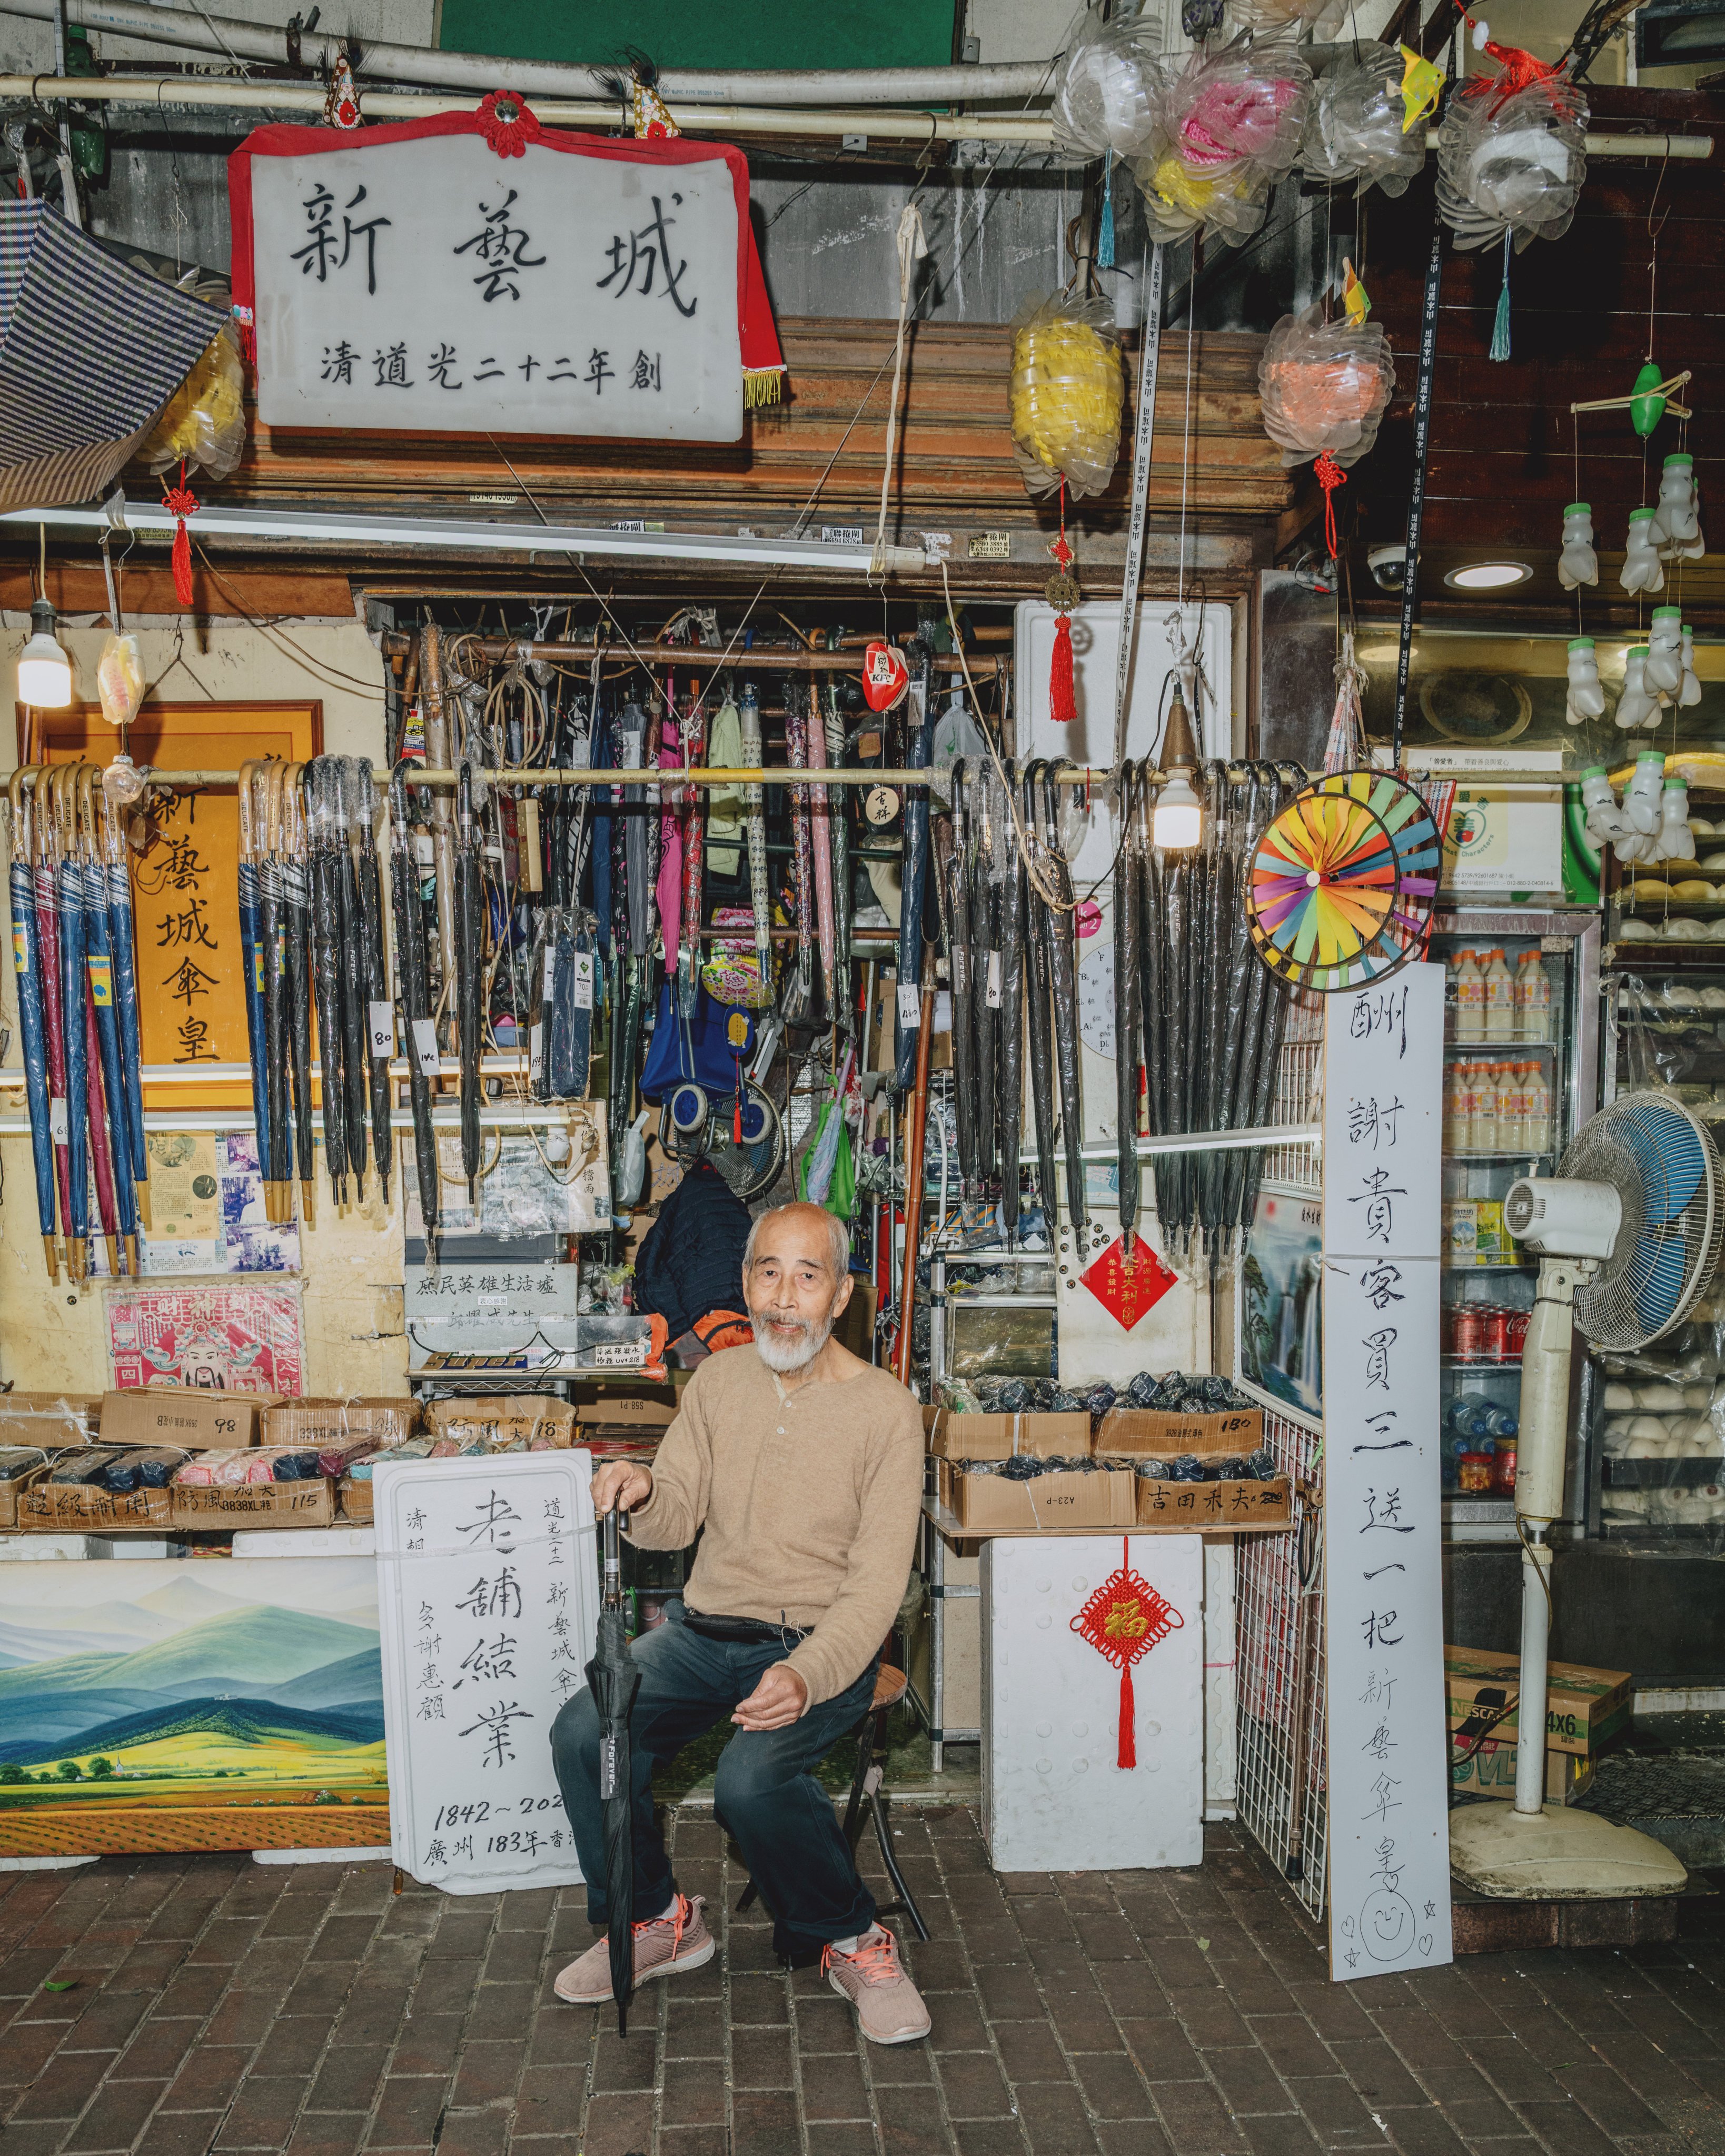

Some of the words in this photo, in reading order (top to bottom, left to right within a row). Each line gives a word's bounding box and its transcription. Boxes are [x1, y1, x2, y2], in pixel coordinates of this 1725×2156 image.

[290, 184, 697, 317] 新藝城
[321, 340, 661, 395] 清道光二十二年創
[872, 674, 891, 683] KFC
[82, 800, 91, 831] DELICATE
[875, 791, 890, 820] 吉祥
[1461, 833, 1495, 858] Characters
[988, 987, 997, 998] 80
[374, 1032, 391, 1045] 80
[1107, 1258, 1117, 1296] 恭喜發財
[1142, 1258, 1152, 1295] 財源廣進
[421, 1352, 526, 1369] Super
[620, 1400, 643, 1410] S58-P1
[215, 1419, 236, 1434] 98
[1222, 1418, 1251, 1432] 180
[292, 1494, 317, 1509] 115
[1046, 1495, 1075, 1505] A23-P
[452, 1489, 534, 1768] 老舖結業
[1105, 1598, 1148, 1641] 福
[547, 1582, 577, 1708] 新藝城傘
[413, 1601, 447, 1721] 多謝惠顧
[423, 1834, 473, 1866] 廣州
